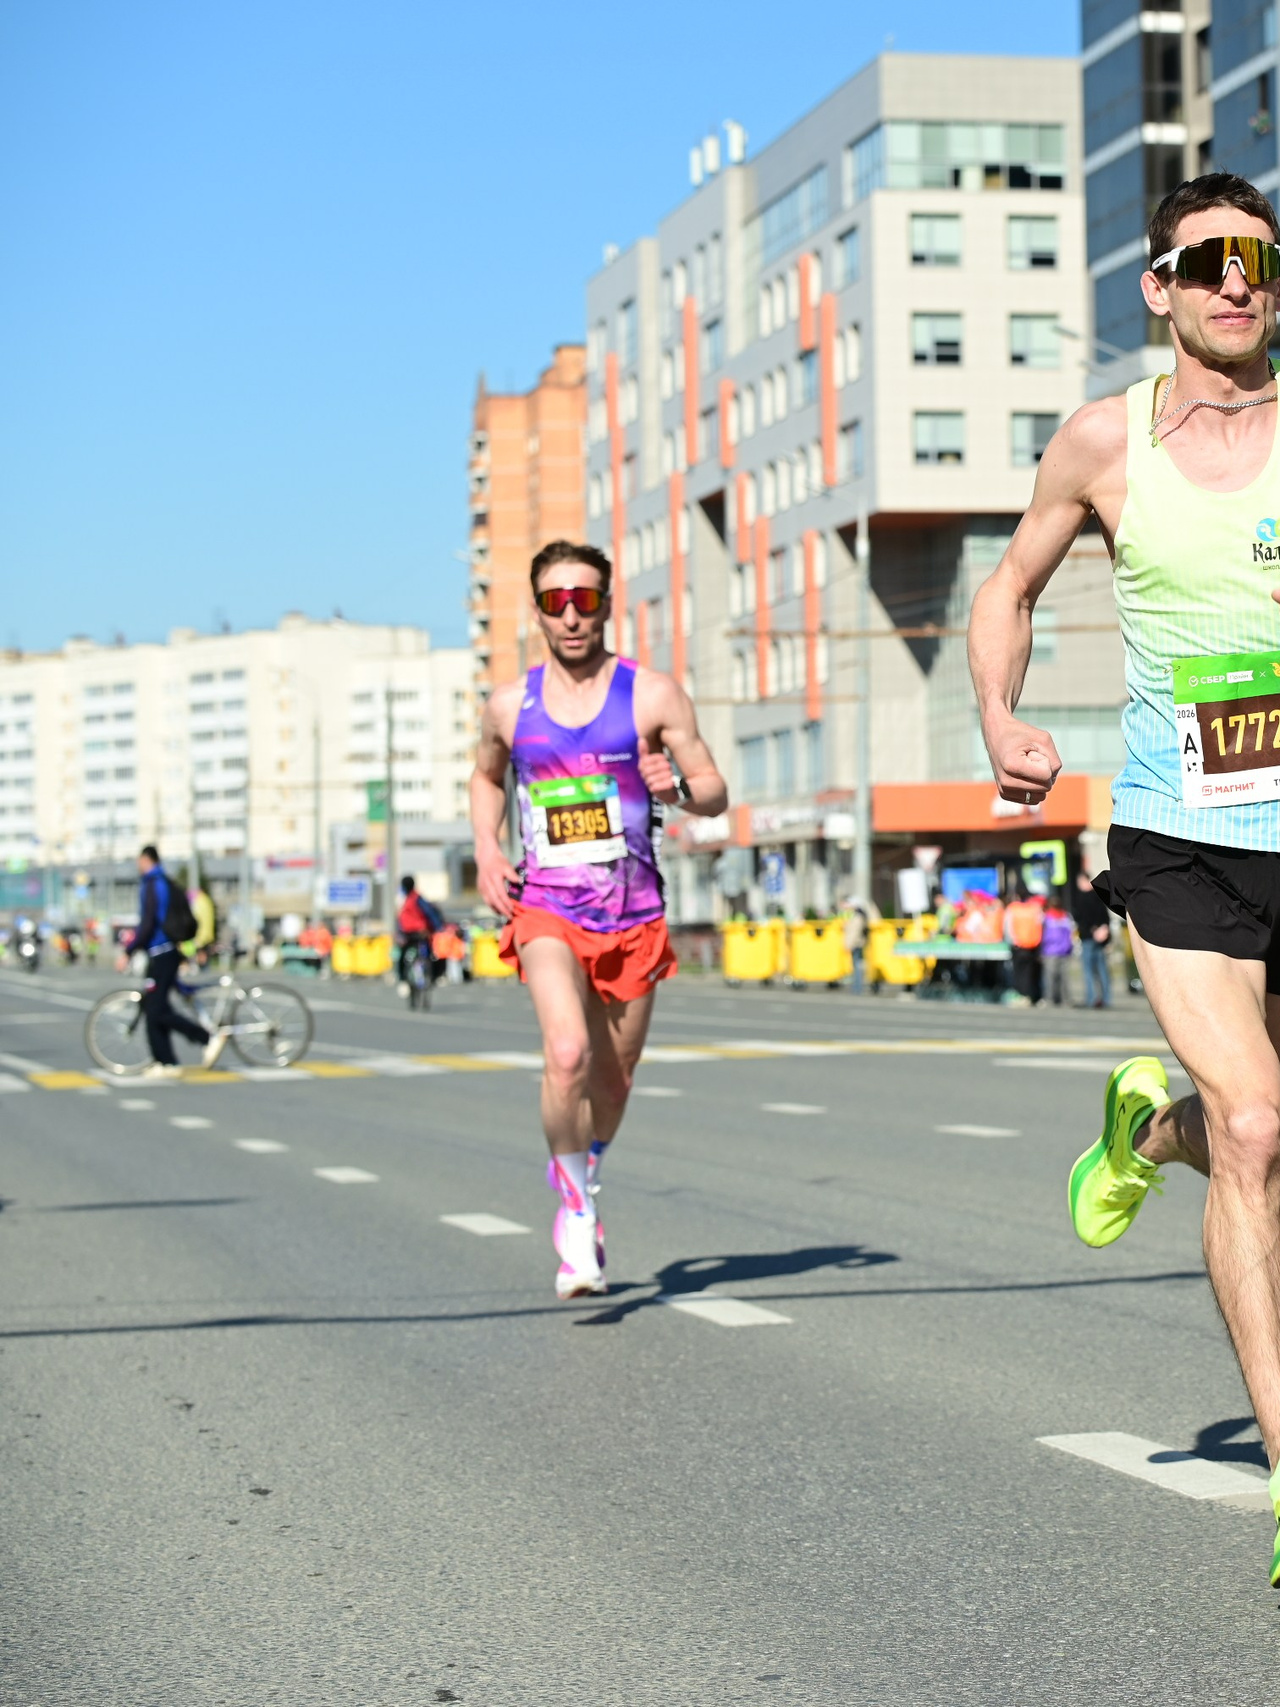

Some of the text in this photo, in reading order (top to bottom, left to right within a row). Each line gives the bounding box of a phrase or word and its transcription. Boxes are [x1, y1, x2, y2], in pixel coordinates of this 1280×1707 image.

[1200, 675, 1226, 685] СБЕР
[1176, 709, 1196, 719] 2026
[1214, 782, 1256, 794] МАГНИТ
[550, 808, 608, 839] 13305
